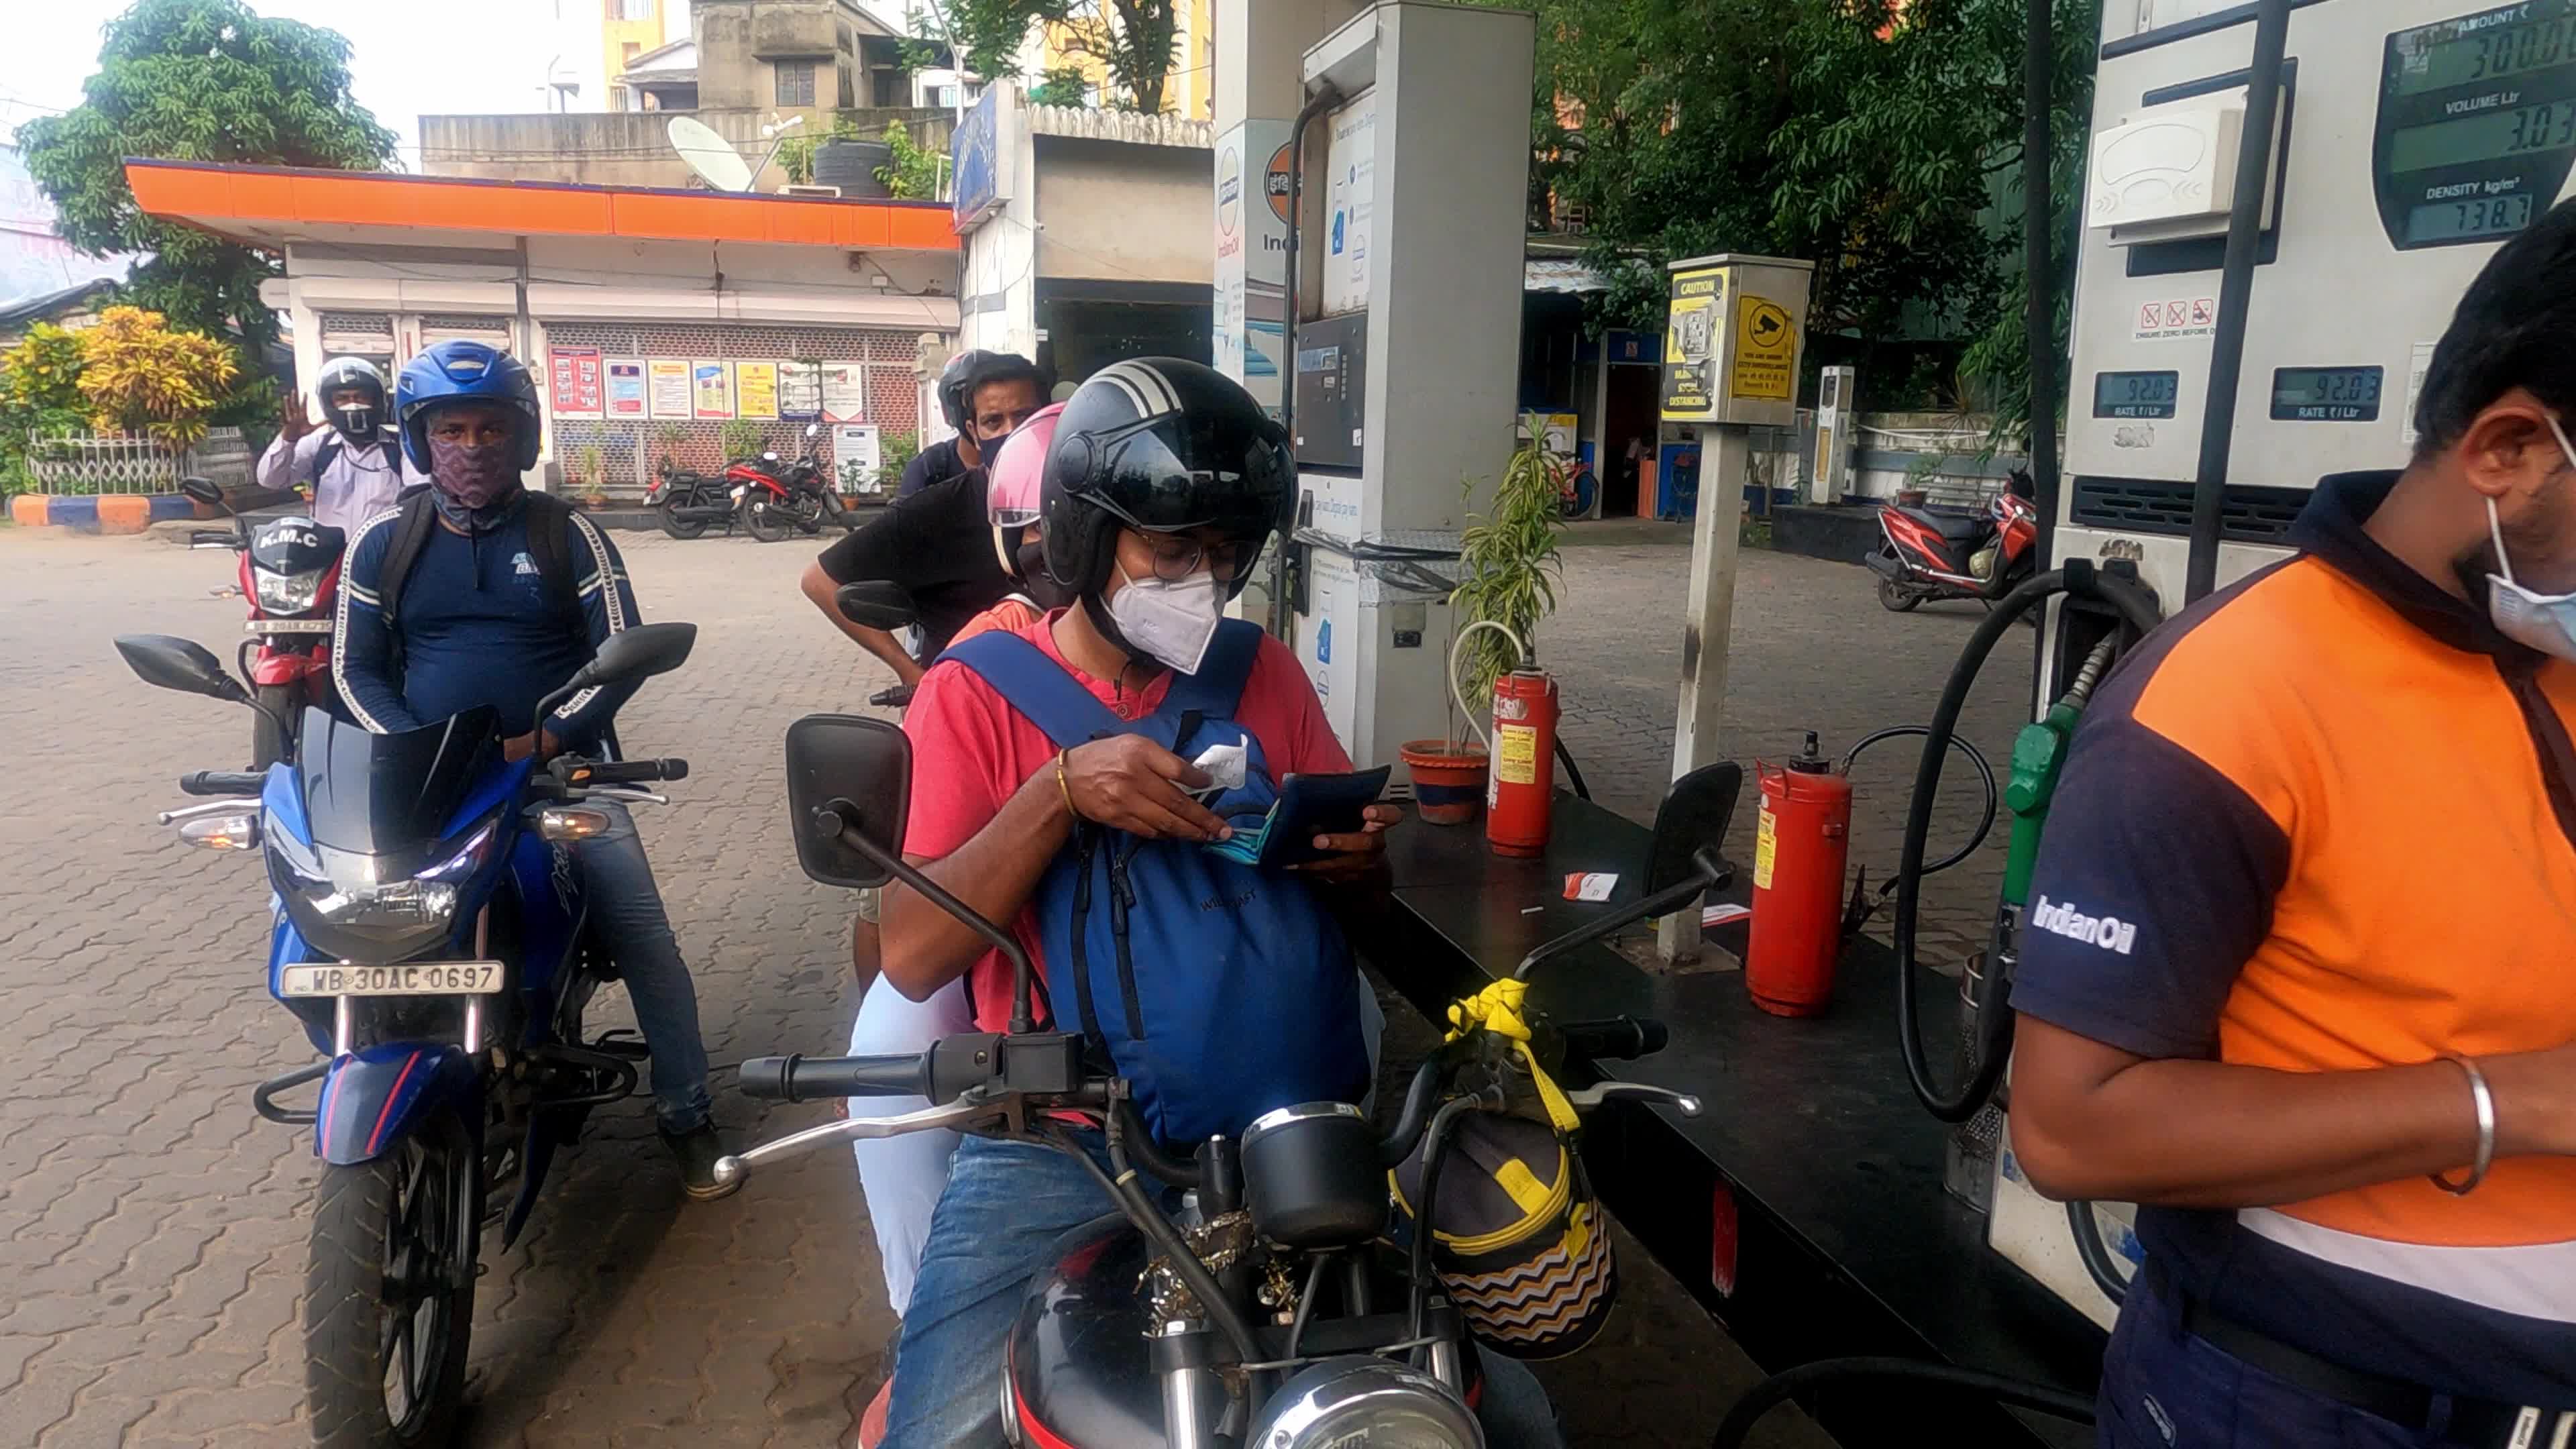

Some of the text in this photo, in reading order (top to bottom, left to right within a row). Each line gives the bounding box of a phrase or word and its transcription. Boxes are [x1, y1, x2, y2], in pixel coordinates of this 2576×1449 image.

[2458, 9, 2515, 36] AMOUNT
[2445, 92, 2521, 114] VOLUME Ltr
[2426, 182, 2480, 200] DENSITY
[2456, 196, 2530, 231] 738.7
[1680, 279, 1715, 295] CAUTION
[2128, 378, 2176, 401] 92.03
[2314, 374, 2381, 401] 92.03
[2114, 407, 2136, 416] RATE
[2298, 407, 2325, 418] RATE
[260, 528, 319, 548] K.M.C
[2033, 894, 2137, 955] IndianOil
[313, 967, 493, 991] WB 30AC 0697
